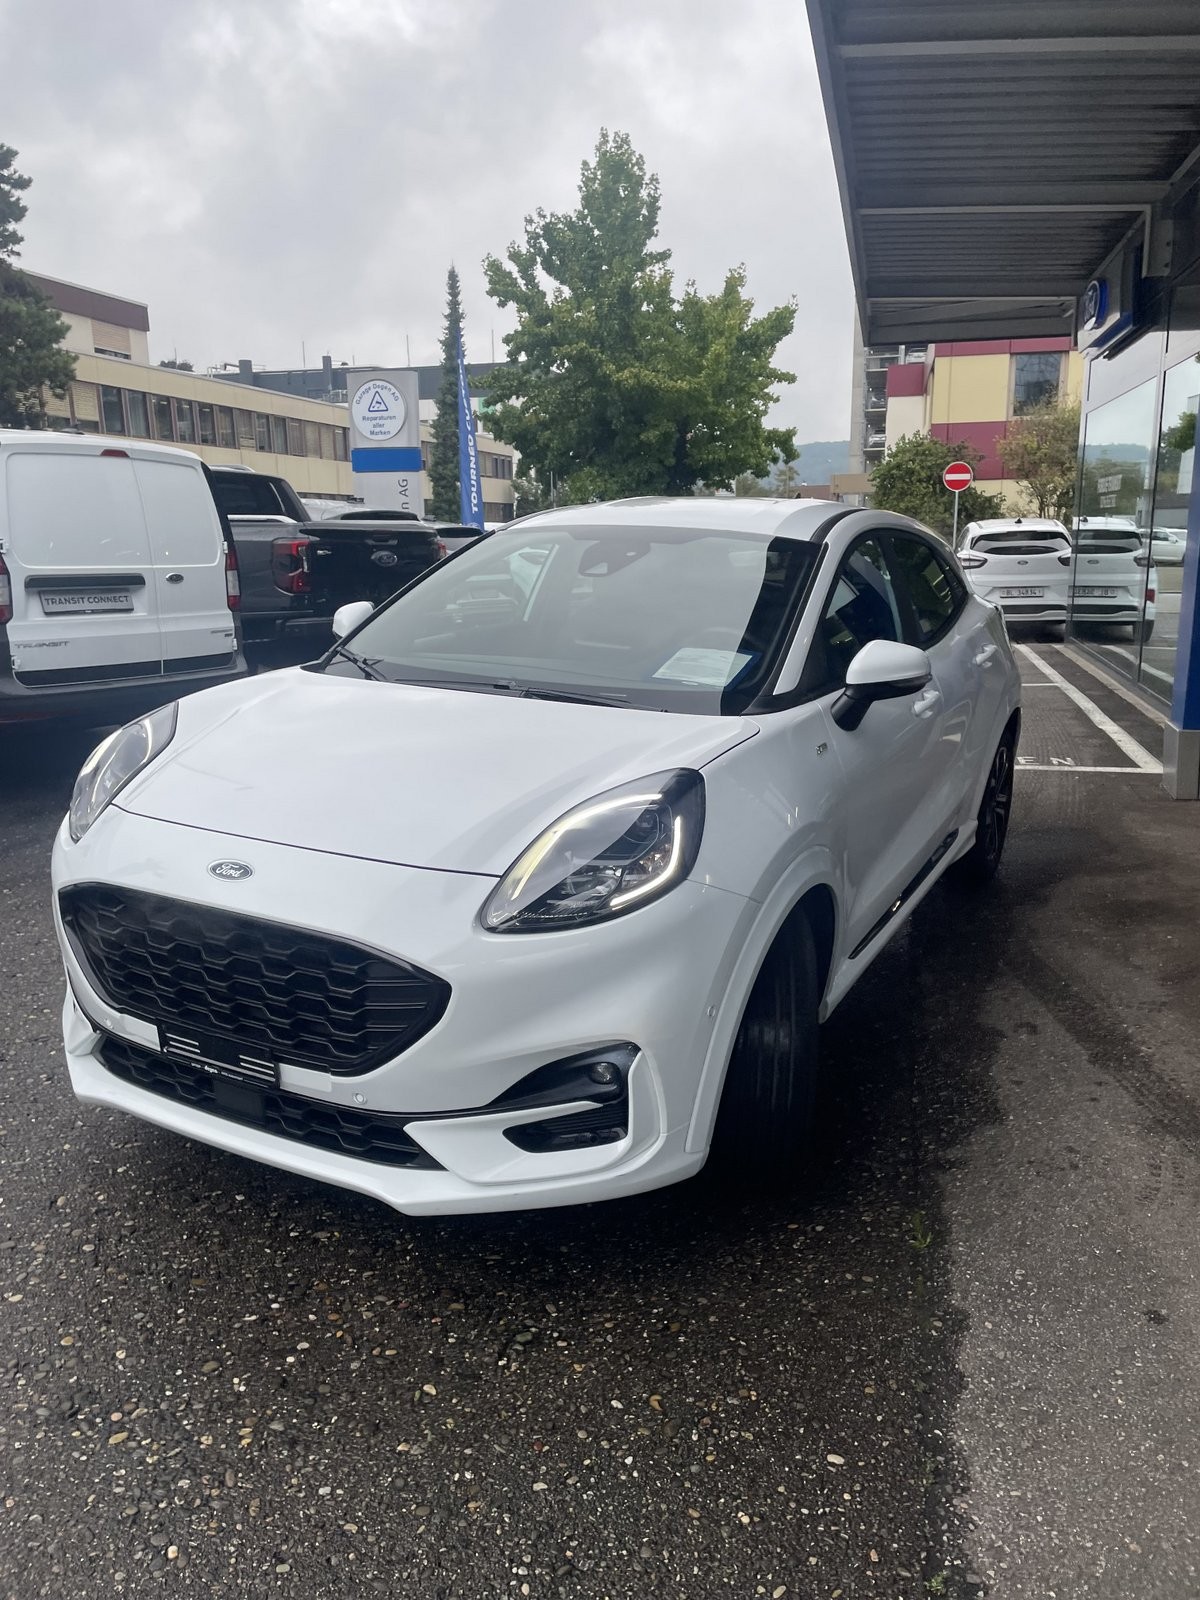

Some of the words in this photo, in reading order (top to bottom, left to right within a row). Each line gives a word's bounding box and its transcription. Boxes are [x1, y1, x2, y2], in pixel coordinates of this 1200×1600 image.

[355, 386, 372, 405] Garage
[391, 391, 400, 402] AG
[466, 436, 480, 514] TOURNEO
[398, 478, 408, 498] AG
[44, 596, 86, 606] TRANSIT
[86, 594, 130, 605] CONNECT
[14, 640, 71, 649] TRANSIT
